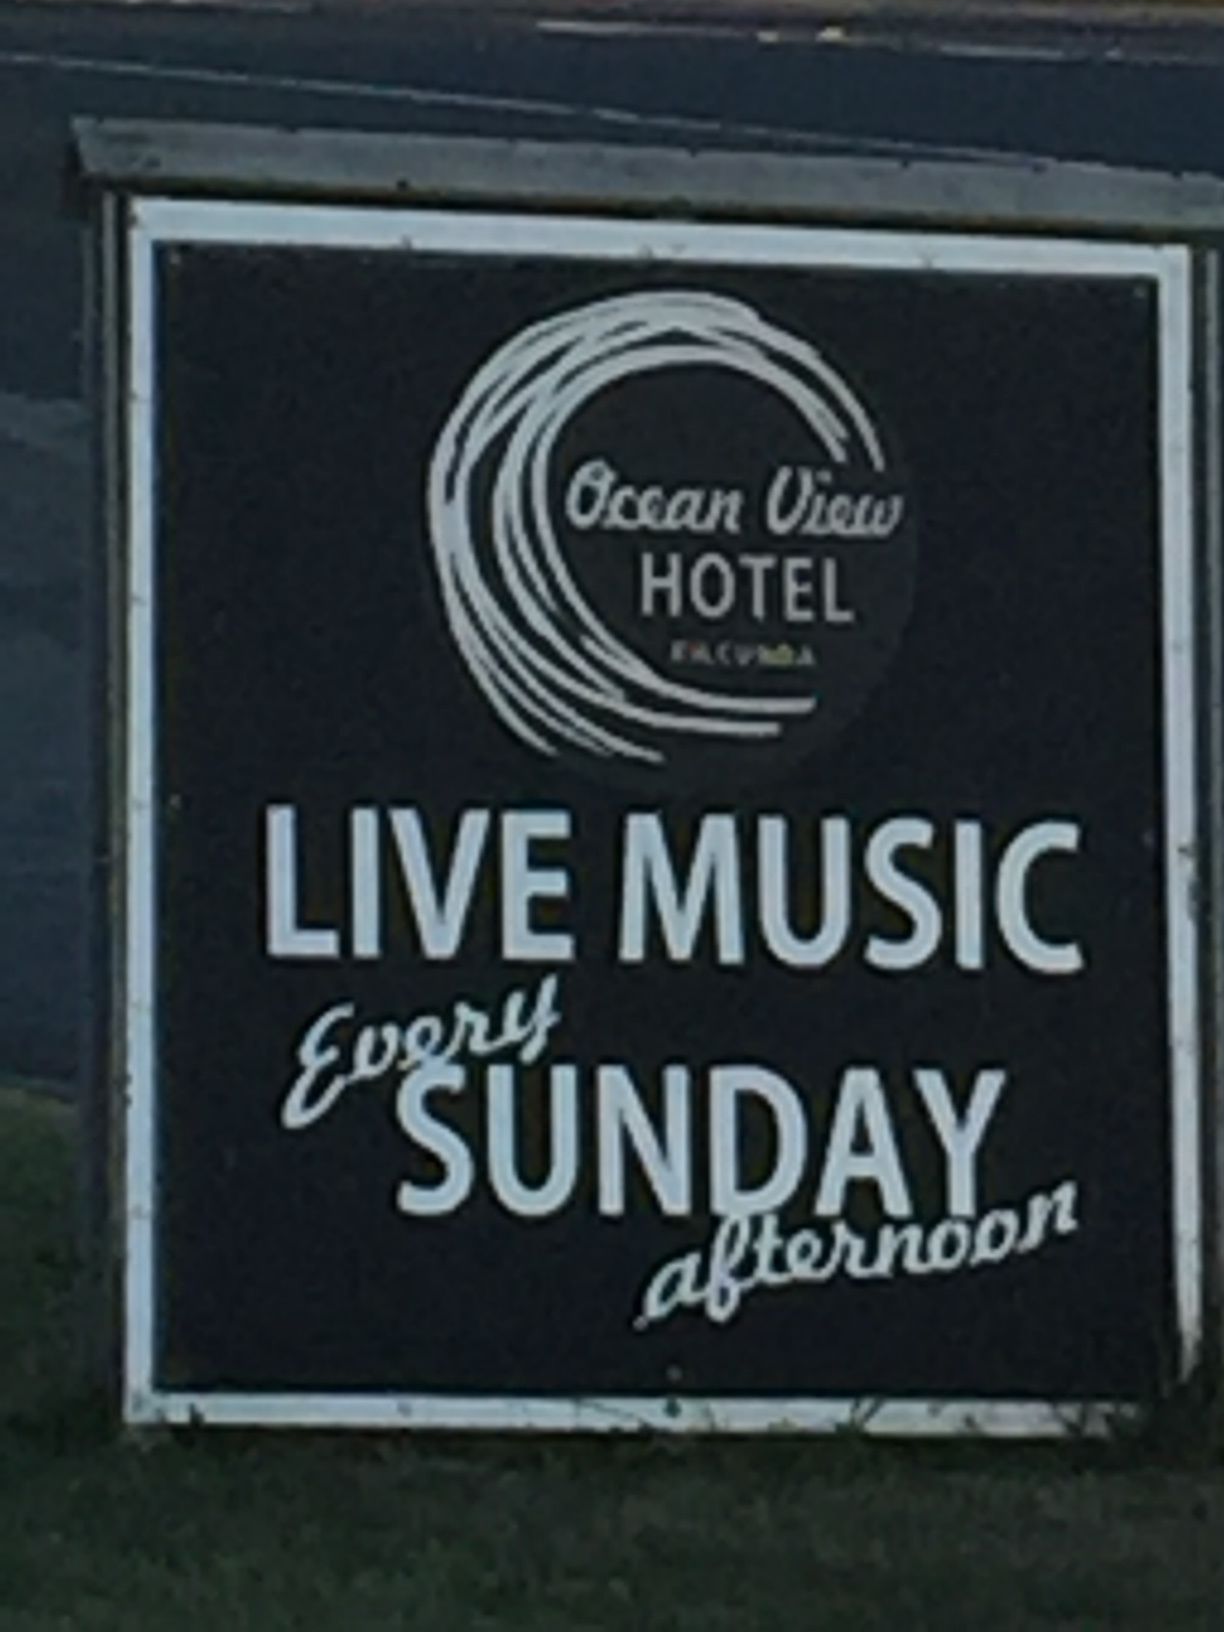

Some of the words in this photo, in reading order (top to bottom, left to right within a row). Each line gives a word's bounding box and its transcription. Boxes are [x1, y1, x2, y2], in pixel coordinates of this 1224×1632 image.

[566, 458, 742, 533] Ocean
[766, 465, 903, 536] View
[640, 552, 854, 622] HOTEL
[266, 805, 573, 959] LIVE
[620, 812, 1083, 974] MUSIC
[281, 973, 561, 1130] Every
[396, 1064, 1006, 1217] SUNDAY
[634, 1180, 1080, 1328] afternoon
